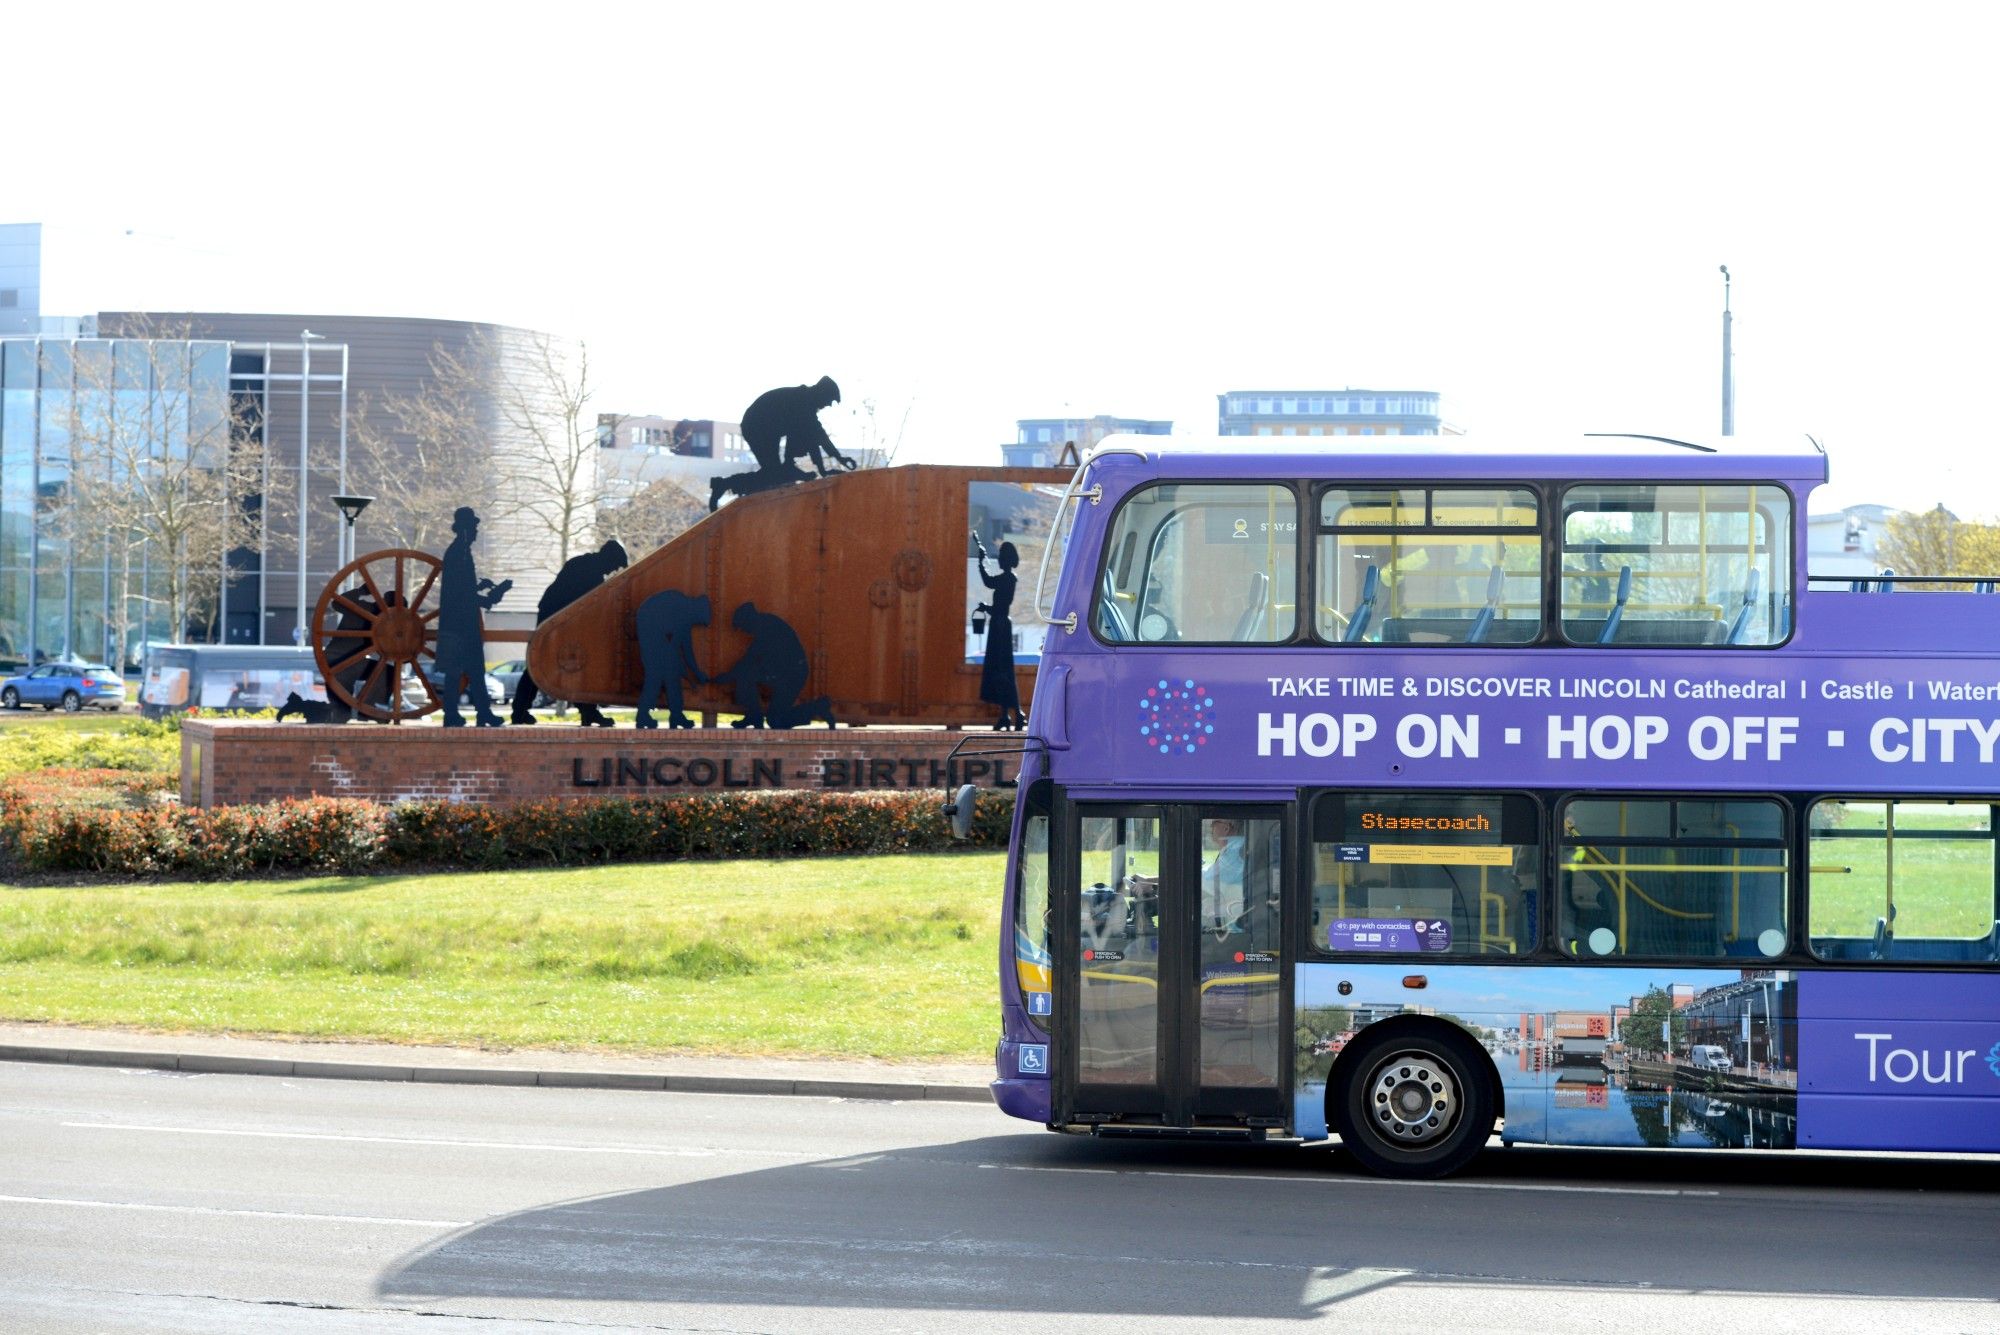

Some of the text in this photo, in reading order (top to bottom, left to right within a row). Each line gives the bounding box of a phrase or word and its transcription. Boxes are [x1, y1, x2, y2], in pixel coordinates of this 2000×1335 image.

[1268, 678, 1330, 696] TAKE
[1337, 678, 1394, 696] TIME
[1402, 678, 1418, 696] &
[1427, 678, 1551, 697] DISCOVER
[1560, 678, 1666, 699] LINCOLN
[1674, 679, 1786, 700] Cathedral
[1821, 680, 1893, 700] Castle
[1258, 713, 2000, 763] HOP ON HOP OFF CITY
[574, 757, 783, 787] LINCOLN
[1361, 813, 1489, 830] Stagecoach
[1349, 923, 1361, 931] pay
[1854, 1033, 1976, 1084] Tour
